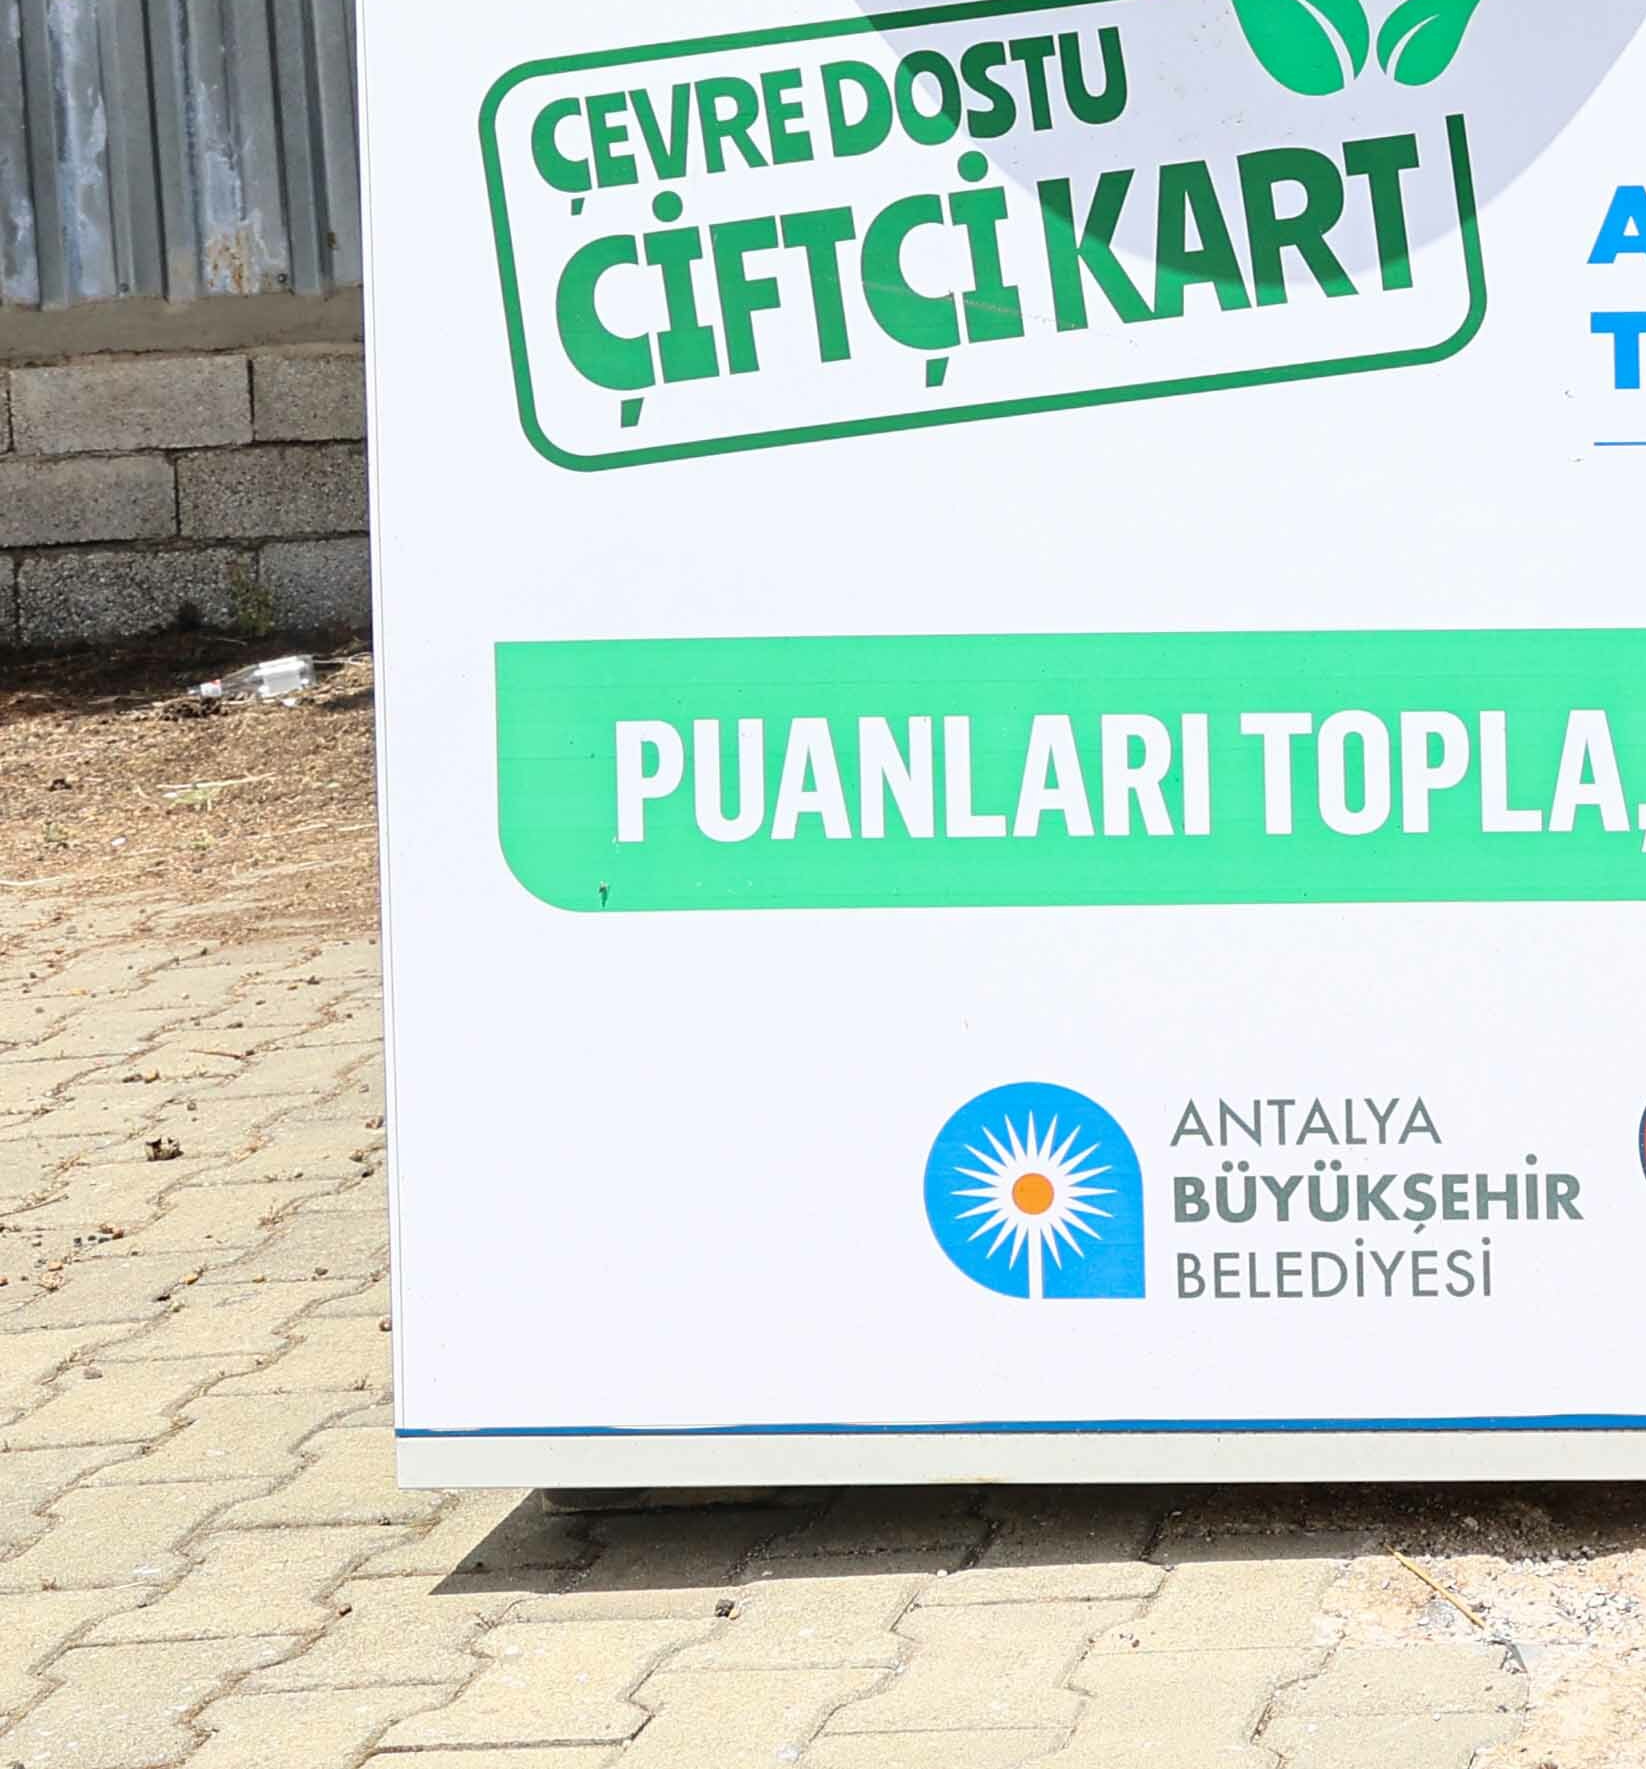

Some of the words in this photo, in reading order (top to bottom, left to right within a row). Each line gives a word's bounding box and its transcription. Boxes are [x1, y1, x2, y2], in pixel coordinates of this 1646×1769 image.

[531, 67, 814, 215] ÇEVRE
[823, 27, 1129, 158] DOSTU
[556, 151, 1025, 429] ÇİFTÇİ
[1037, 133, 1420, 333] KART
[615, 715, 1211, 843] PUANLARI
[1170, 1097, 1442, 1146] ANTALYA
[1173, 1154, 1584, 1233] BÜYÜKŞEHİR
[1176, 1236, 1491, 1299] BELEDİYESİ
